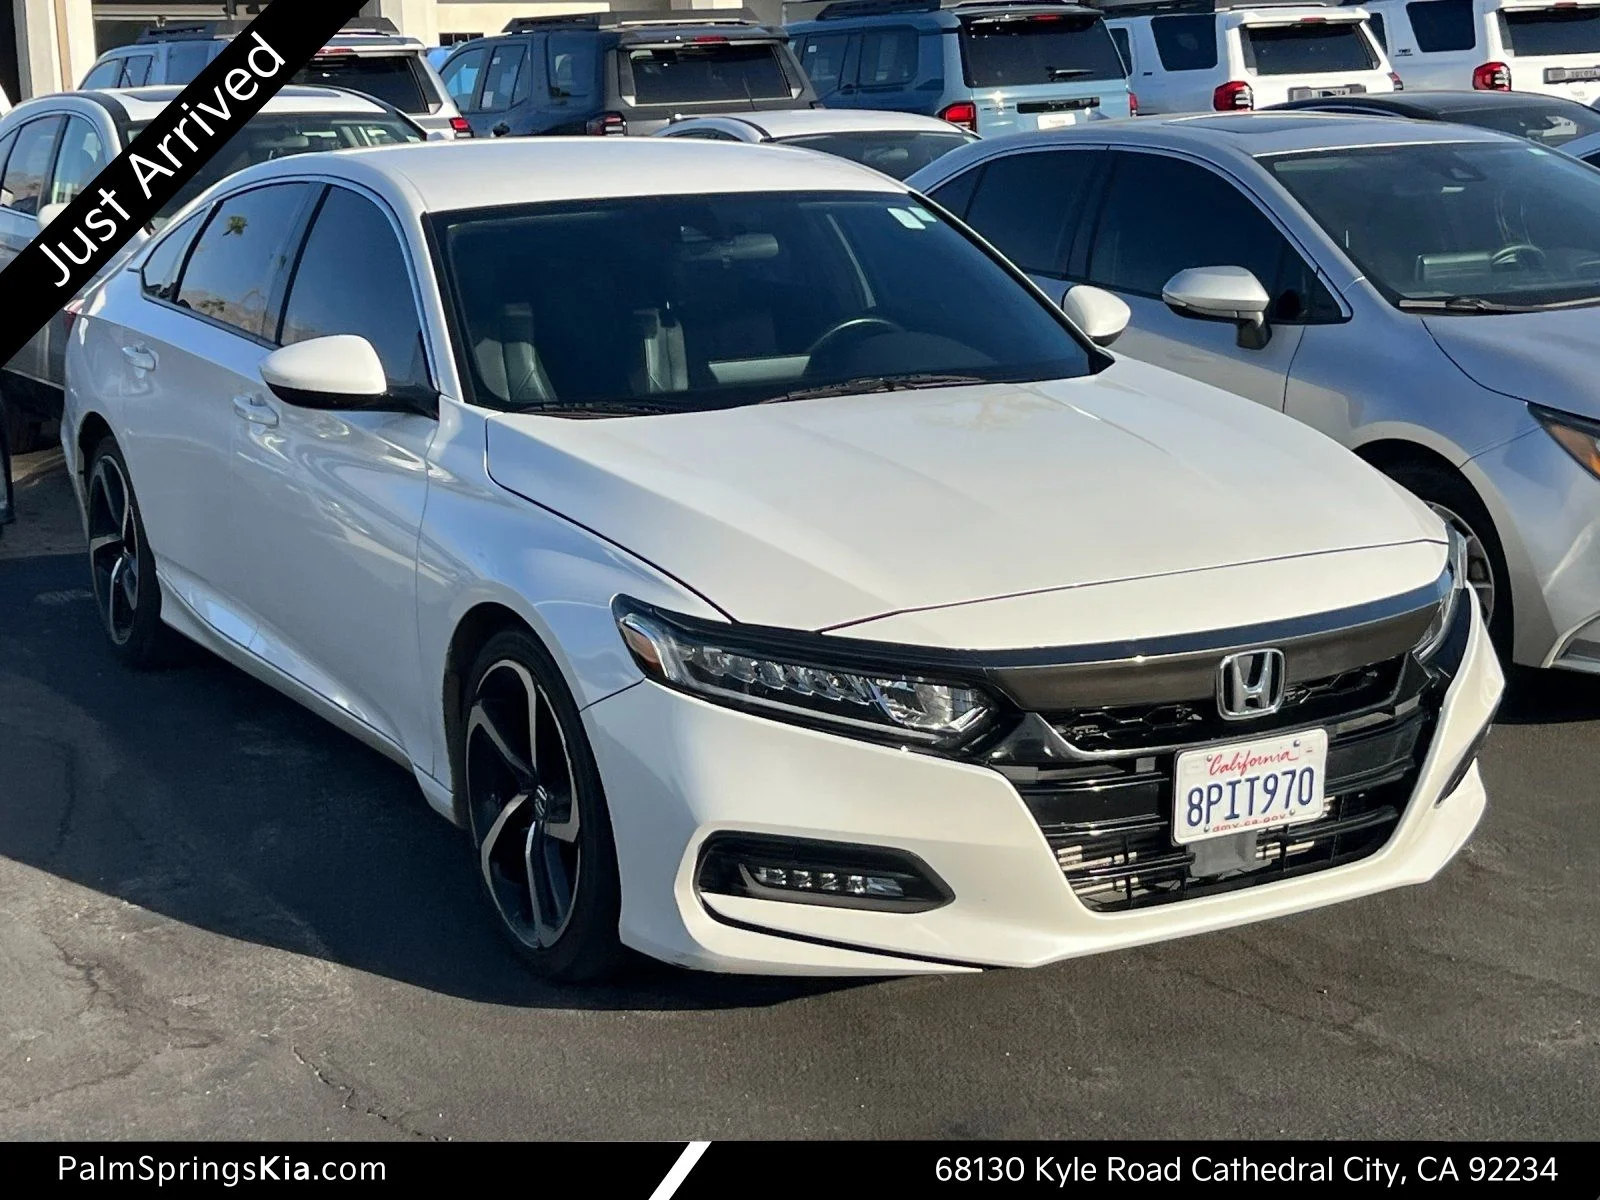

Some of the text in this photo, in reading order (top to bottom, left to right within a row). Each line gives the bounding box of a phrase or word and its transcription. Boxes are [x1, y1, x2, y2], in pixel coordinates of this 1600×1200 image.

[1208, 750, 1299, 776] California
[1187, 767, 1315, 828] 8PIT970
[1212, 814, 1287, 833] dmv.ca.gov
